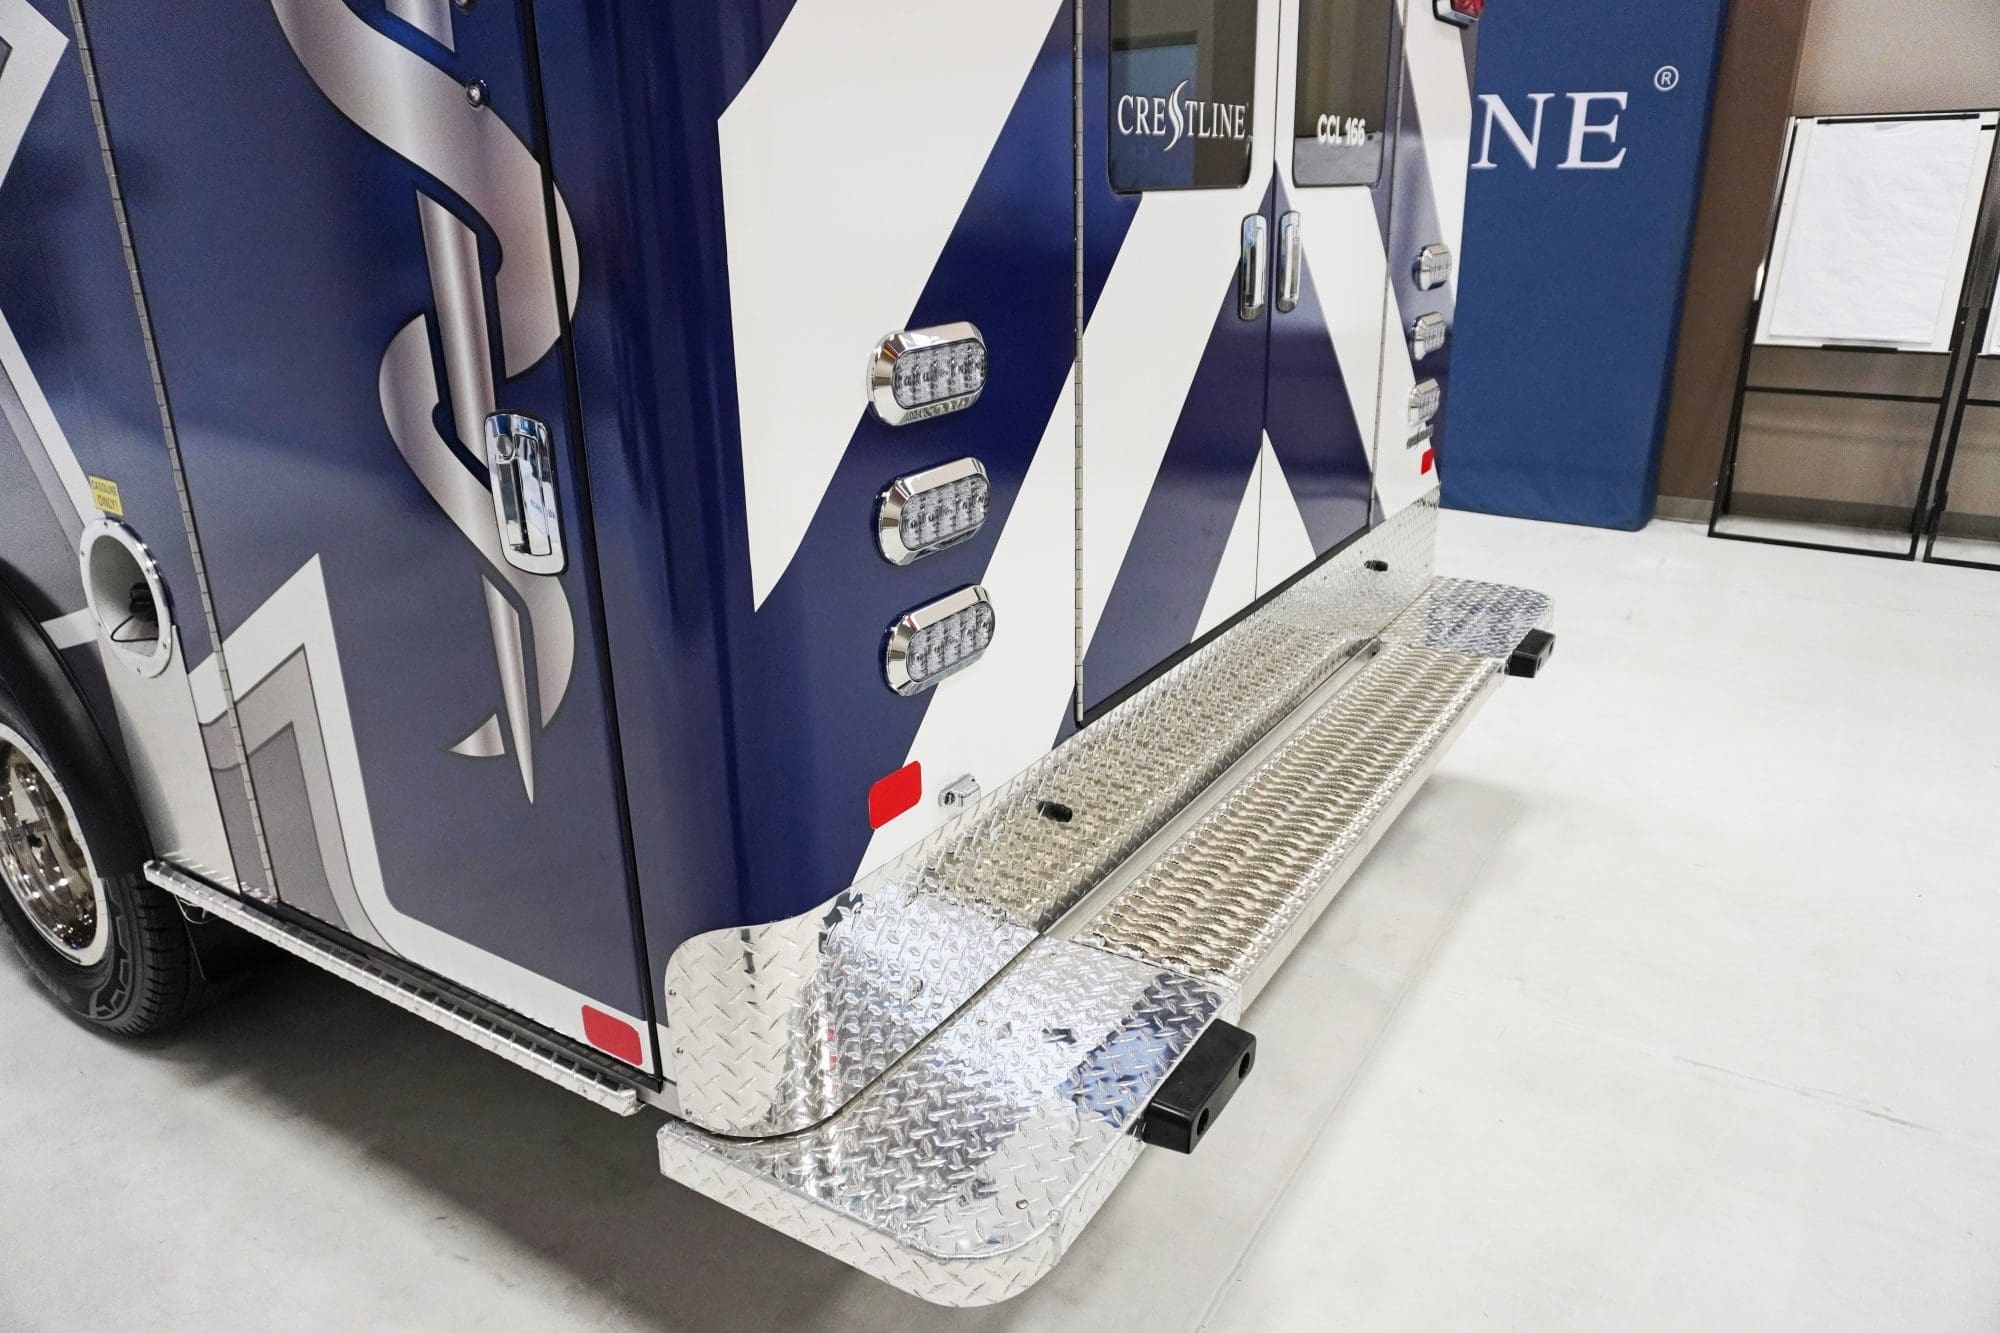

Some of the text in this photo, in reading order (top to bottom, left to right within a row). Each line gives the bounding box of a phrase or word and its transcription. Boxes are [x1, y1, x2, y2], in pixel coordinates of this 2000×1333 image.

[1117, 80, 1246, 151] CRESTLINE
[1317, 113, 1366, 147] CCL 166
